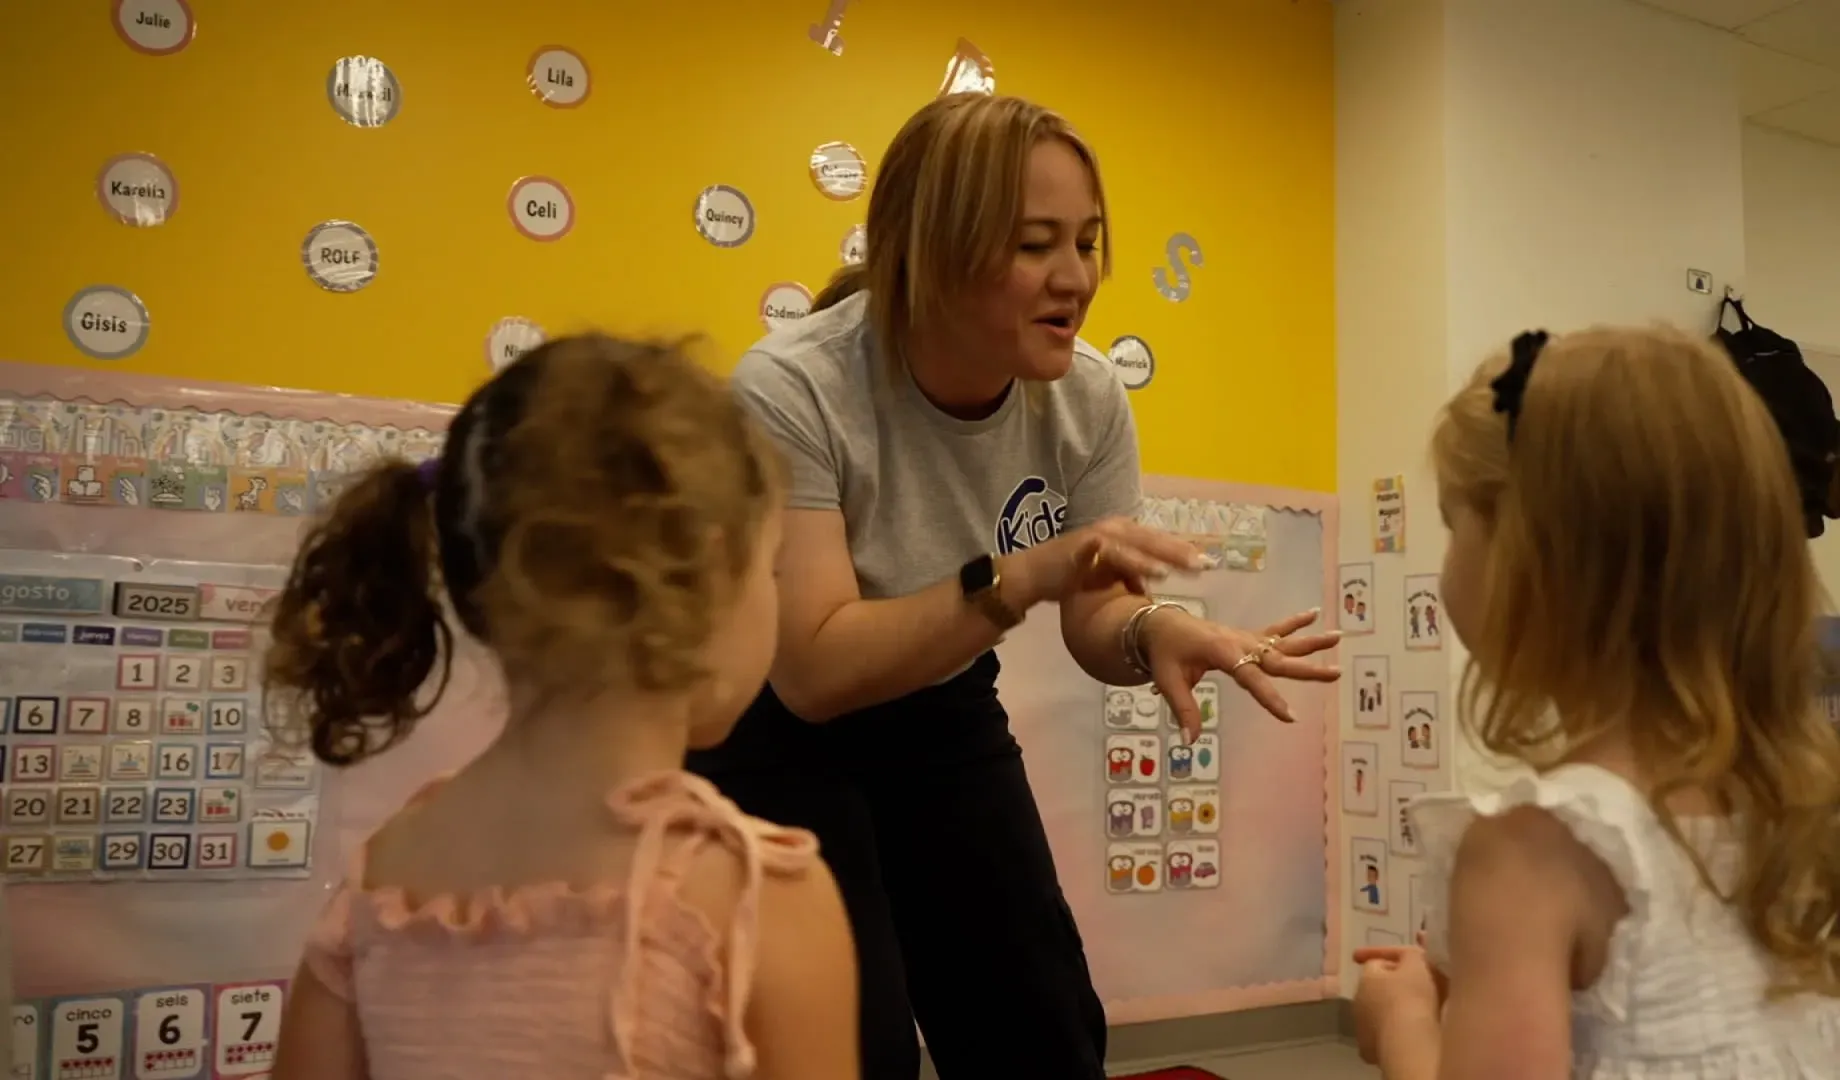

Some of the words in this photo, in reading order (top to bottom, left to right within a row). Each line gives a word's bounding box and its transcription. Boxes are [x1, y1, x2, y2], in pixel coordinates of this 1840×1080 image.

[135, 11, 172, 30] Julie
[546, 67, 575, 89] Lila
[526, 200, 558, 219] Celi
[706, 208, 744, 229] Quincy
[321, 247, 361, 265] ROLF
[80, 312, 128, 334] Gisis
[1000, 500, 1067, 556] Kids
[127, 594, 191, 615] 2025
[131, 663, 143, 683] 1
[175, 664, 191, 684] 2
[221, 665, 236, 684] 3
[27, 705, 44, 727] 6
[78, 708, 94, 727] 7
[126, 709, 141, 727] 8
[212, 708, 241, 727] 10
[19, 755, 49, 774] 13
[162, 753, 190, 772] 16
[211, 752, 240, 771] 17
[13, 798, 46, 817] 20
[63, 798, 92, 816] 21
[110, 796, 142, 815] 22
[158, 797, 188, 816] 23
[9, 844, 43, 864] 27
[107, 841, 138, 861] 29
[153, 842, 184, 861] 30
[201, 843, 229, 862] 31
[156, 993, 189, 1008] seis
[231, 988, 271, 1006] siete
[66, 1007, 112, 1022] cinco
[158, 1014, 182, 1045] 6
[240, 1011, 263, 1042] 7
[76, 1023, 100, 1054] 5
